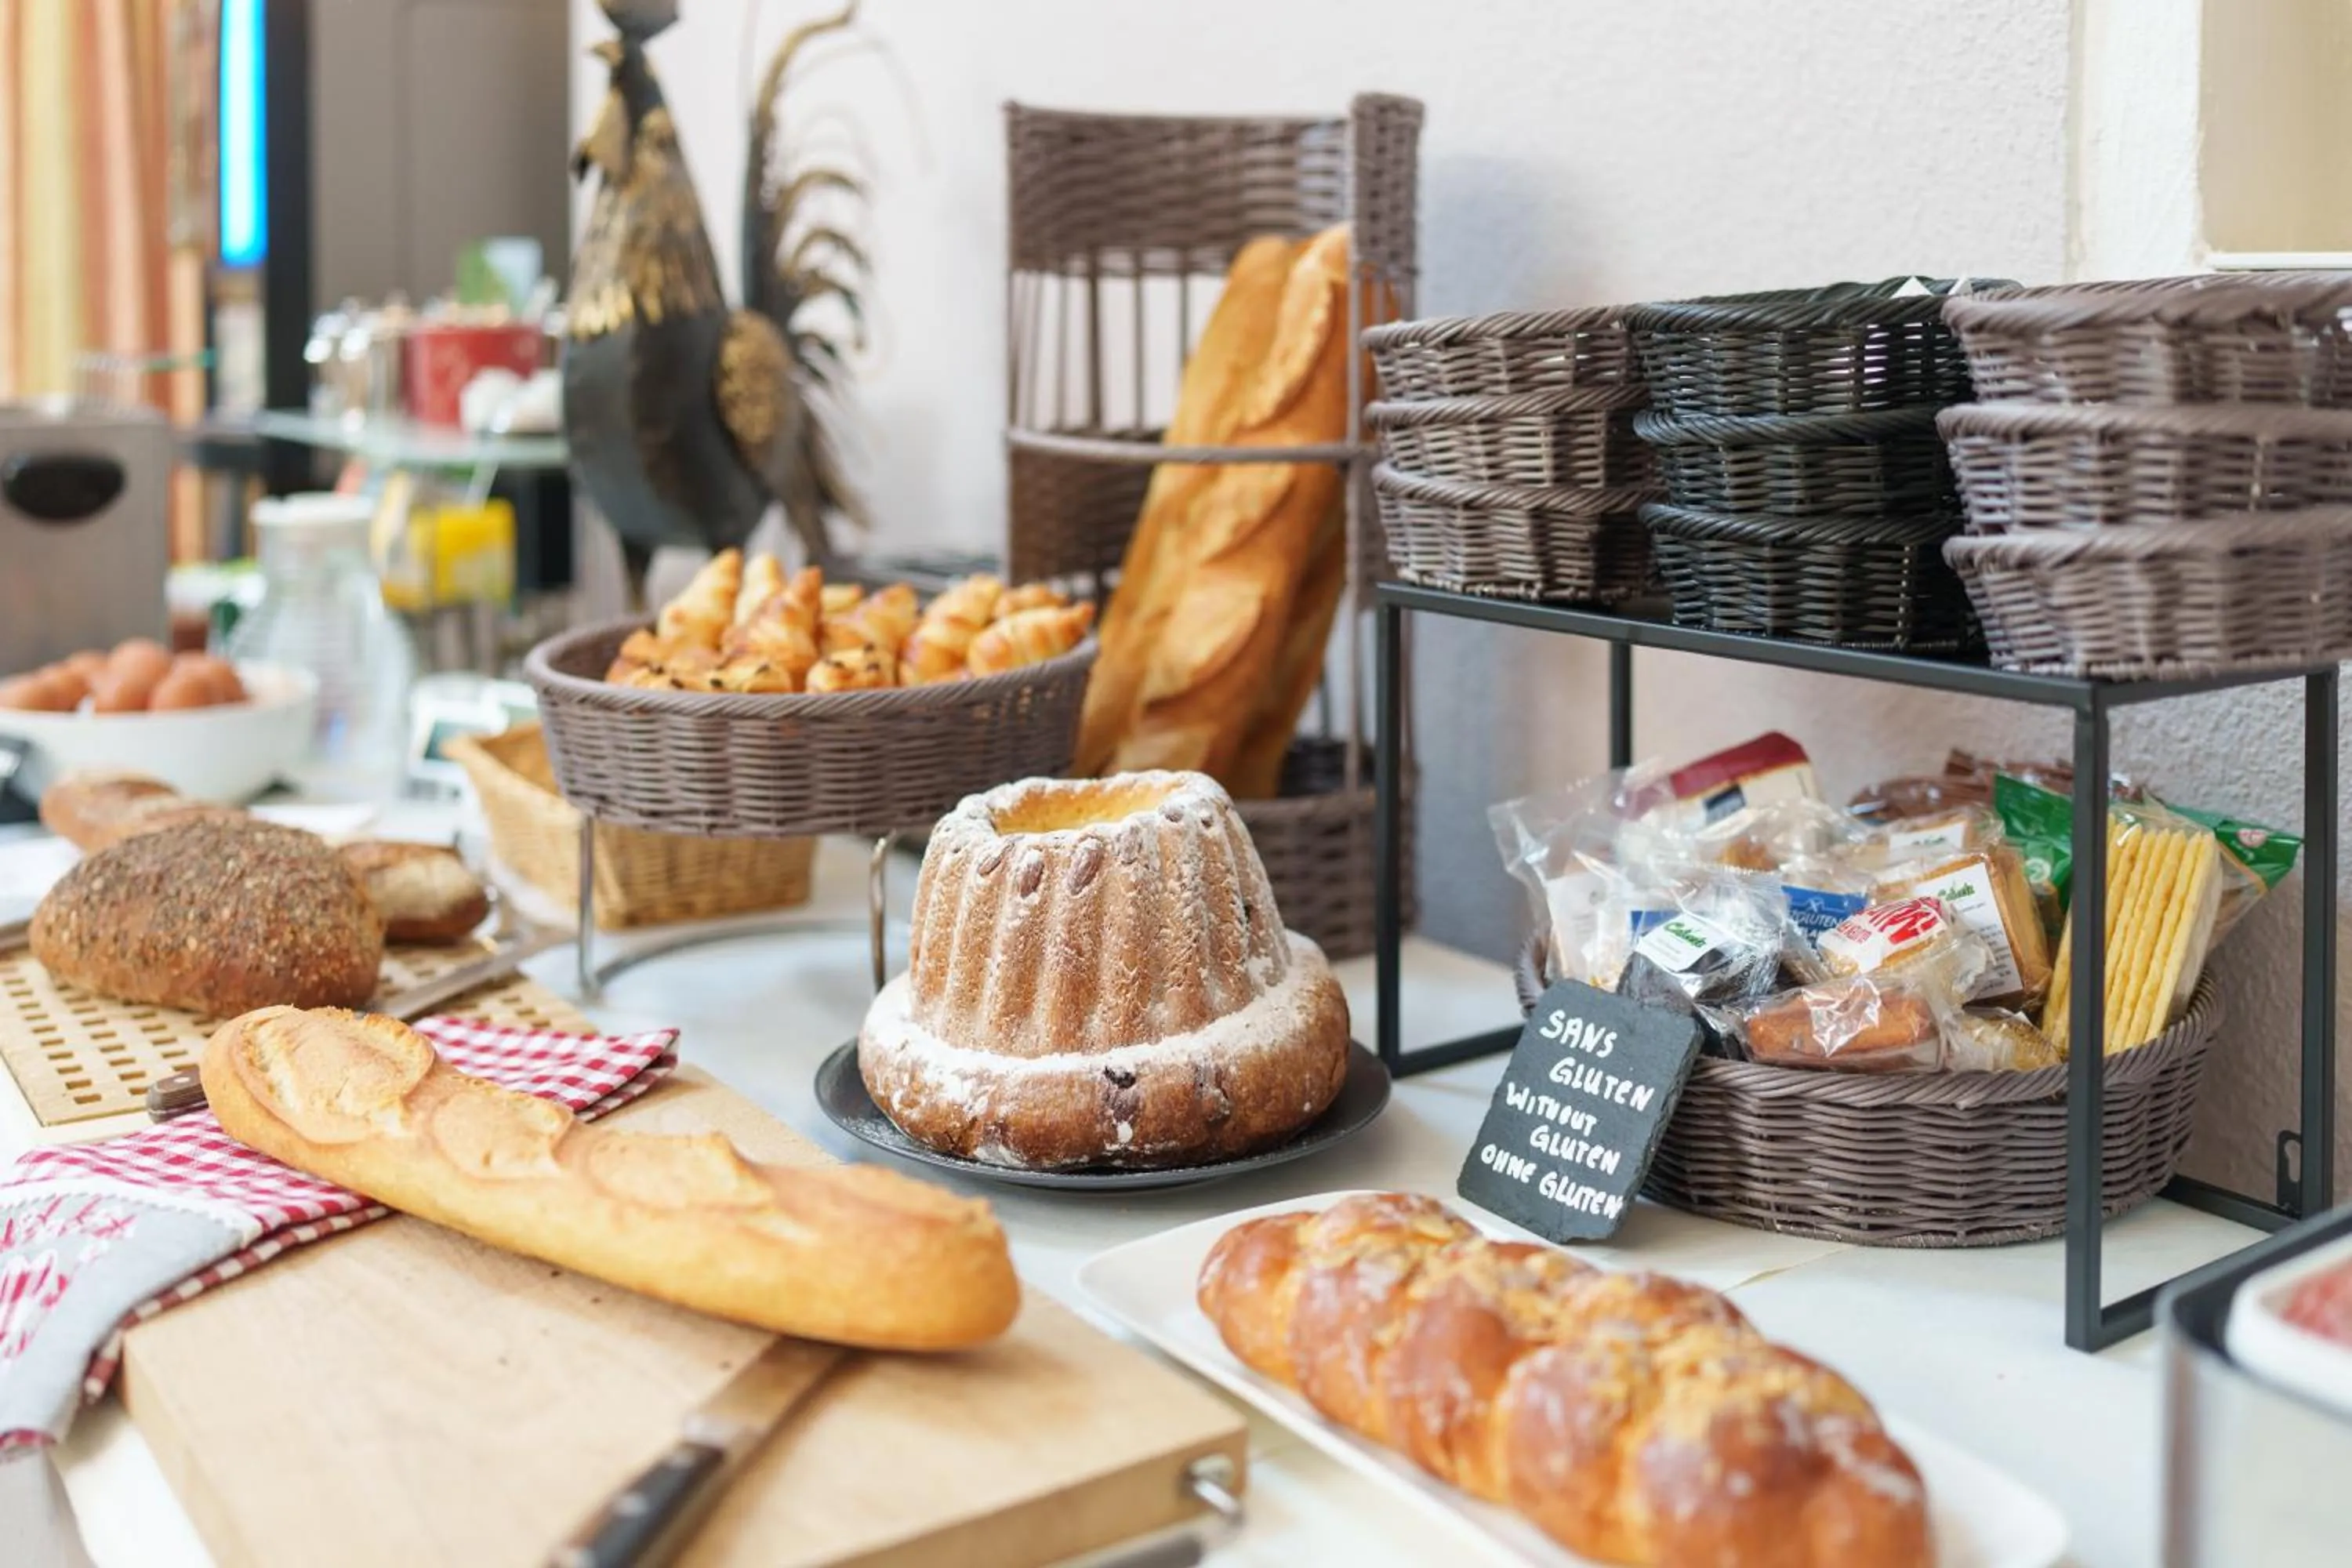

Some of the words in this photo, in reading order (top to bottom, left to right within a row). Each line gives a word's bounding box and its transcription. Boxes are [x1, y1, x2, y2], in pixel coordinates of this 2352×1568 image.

[1539, 1010, 1618, 1058] SANS
[1506, 1082, 1598, 1137] WITHOUT
[1548, 1057, 1655, 1112] GLUTEN
[1530, 1124, 1621, 1175] GLUTEN
[1480, 1143, 1537, 1184] OHNE
[1539, 1171, 1624, 1219] GLUTEN
